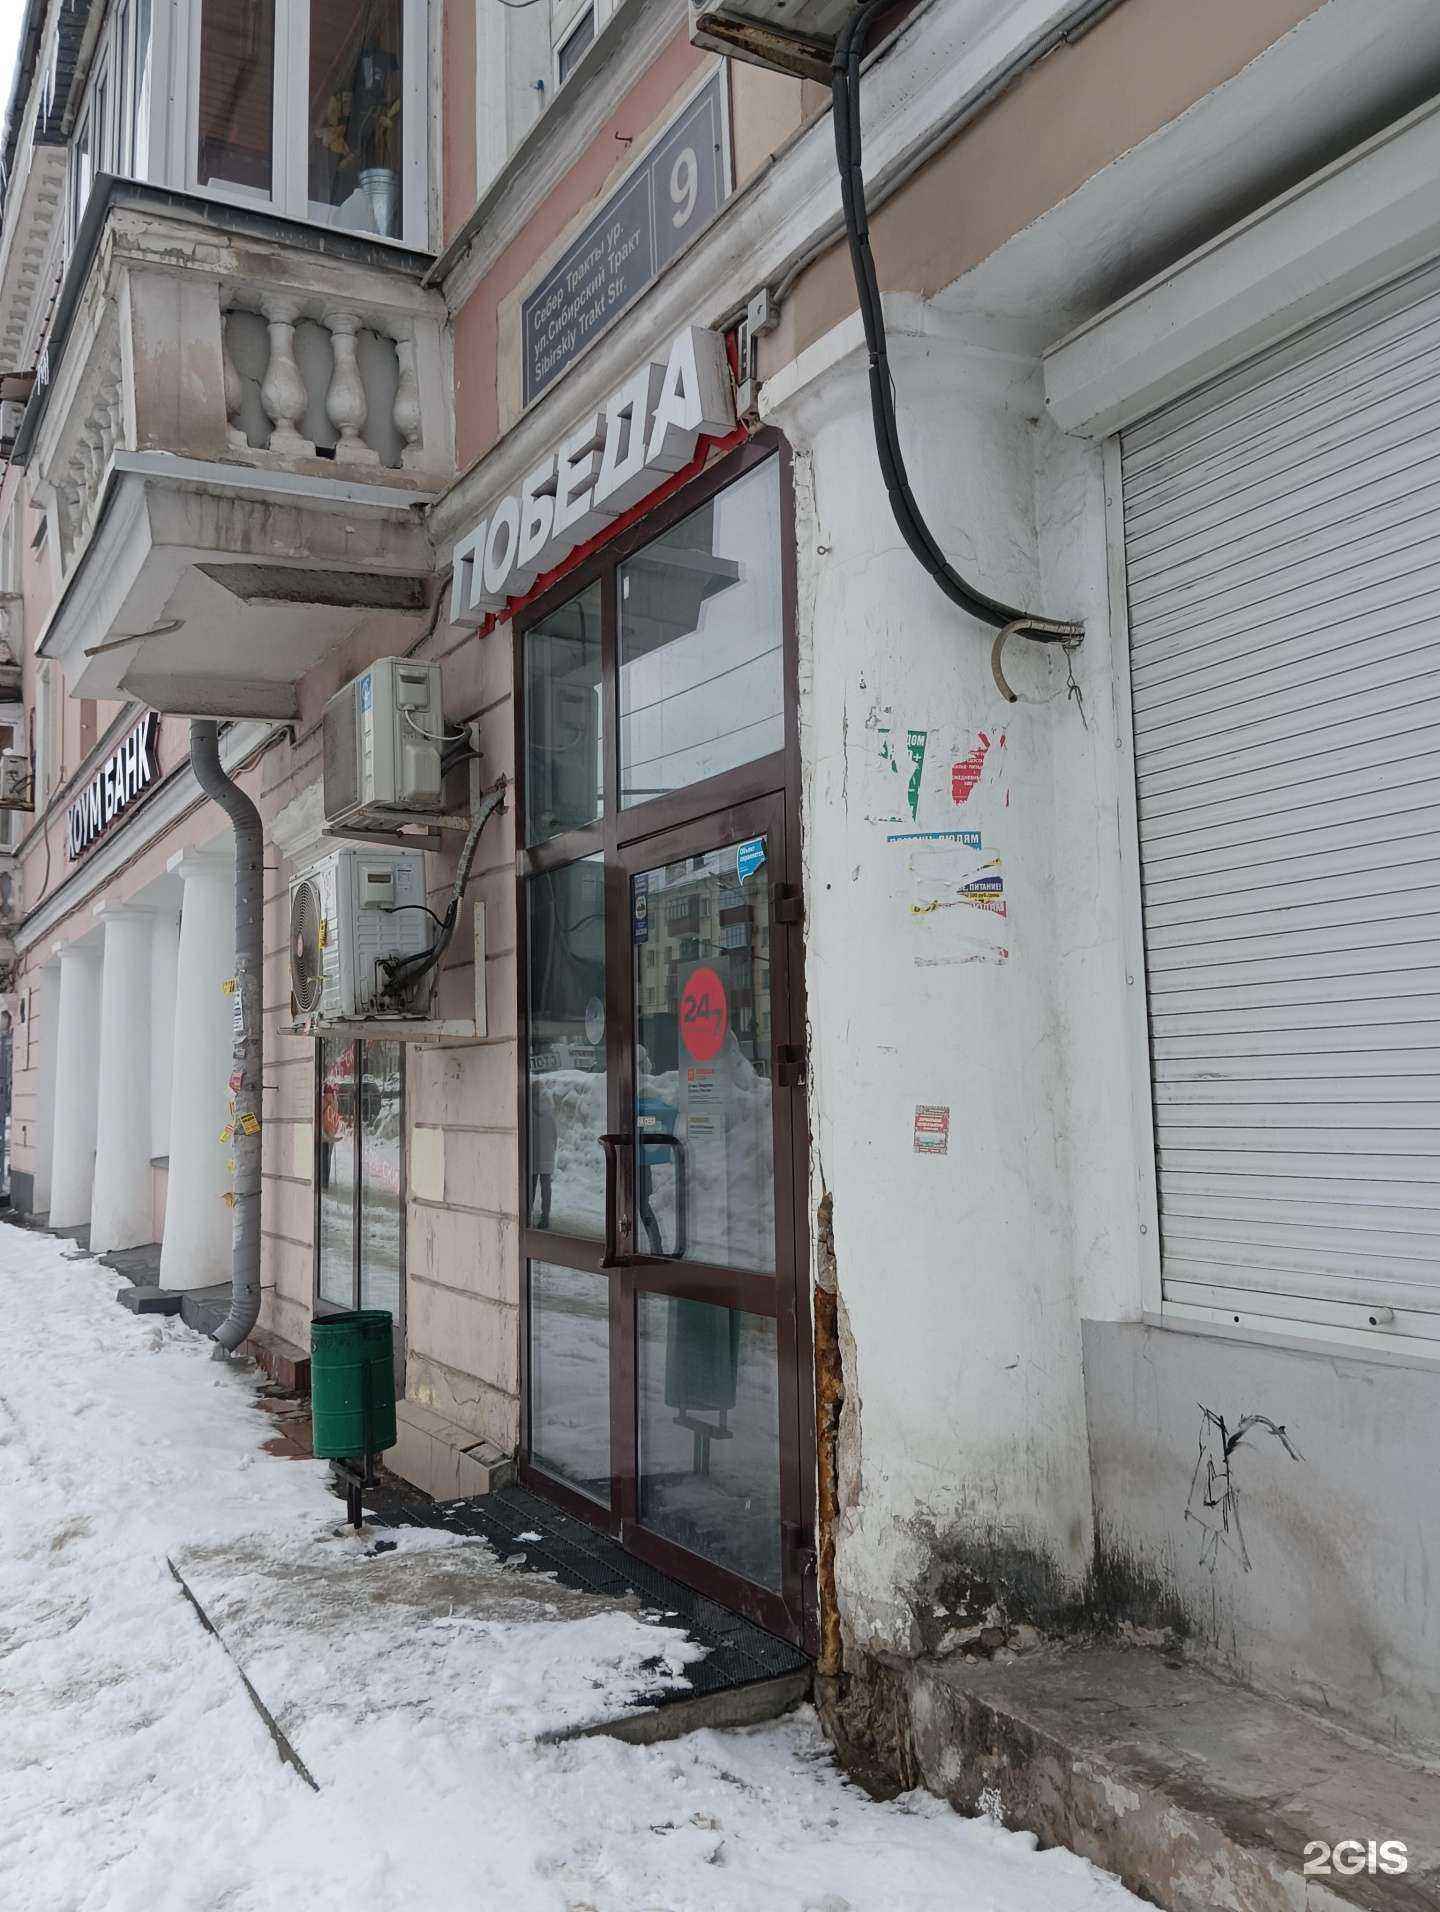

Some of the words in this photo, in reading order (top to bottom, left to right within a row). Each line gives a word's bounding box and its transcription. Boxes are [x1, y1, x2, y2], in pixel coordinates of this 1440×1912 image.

[670, 146, 698, 229] 9
[534, 288, 564, 330] Себер
[566, 241, 605, 293] Тракты
[607, 222, 624, 251] ур.
[608, 229, 641, 274] Тракт
[534, 328, 577, 382] Sibirskiy
[578, 296, 606, 335] Trakt
[608, 277, 628, 304] Str.
[450, 326, 716, 626] ПОБЕДА
[105, 711, 155, 824] БАНК
